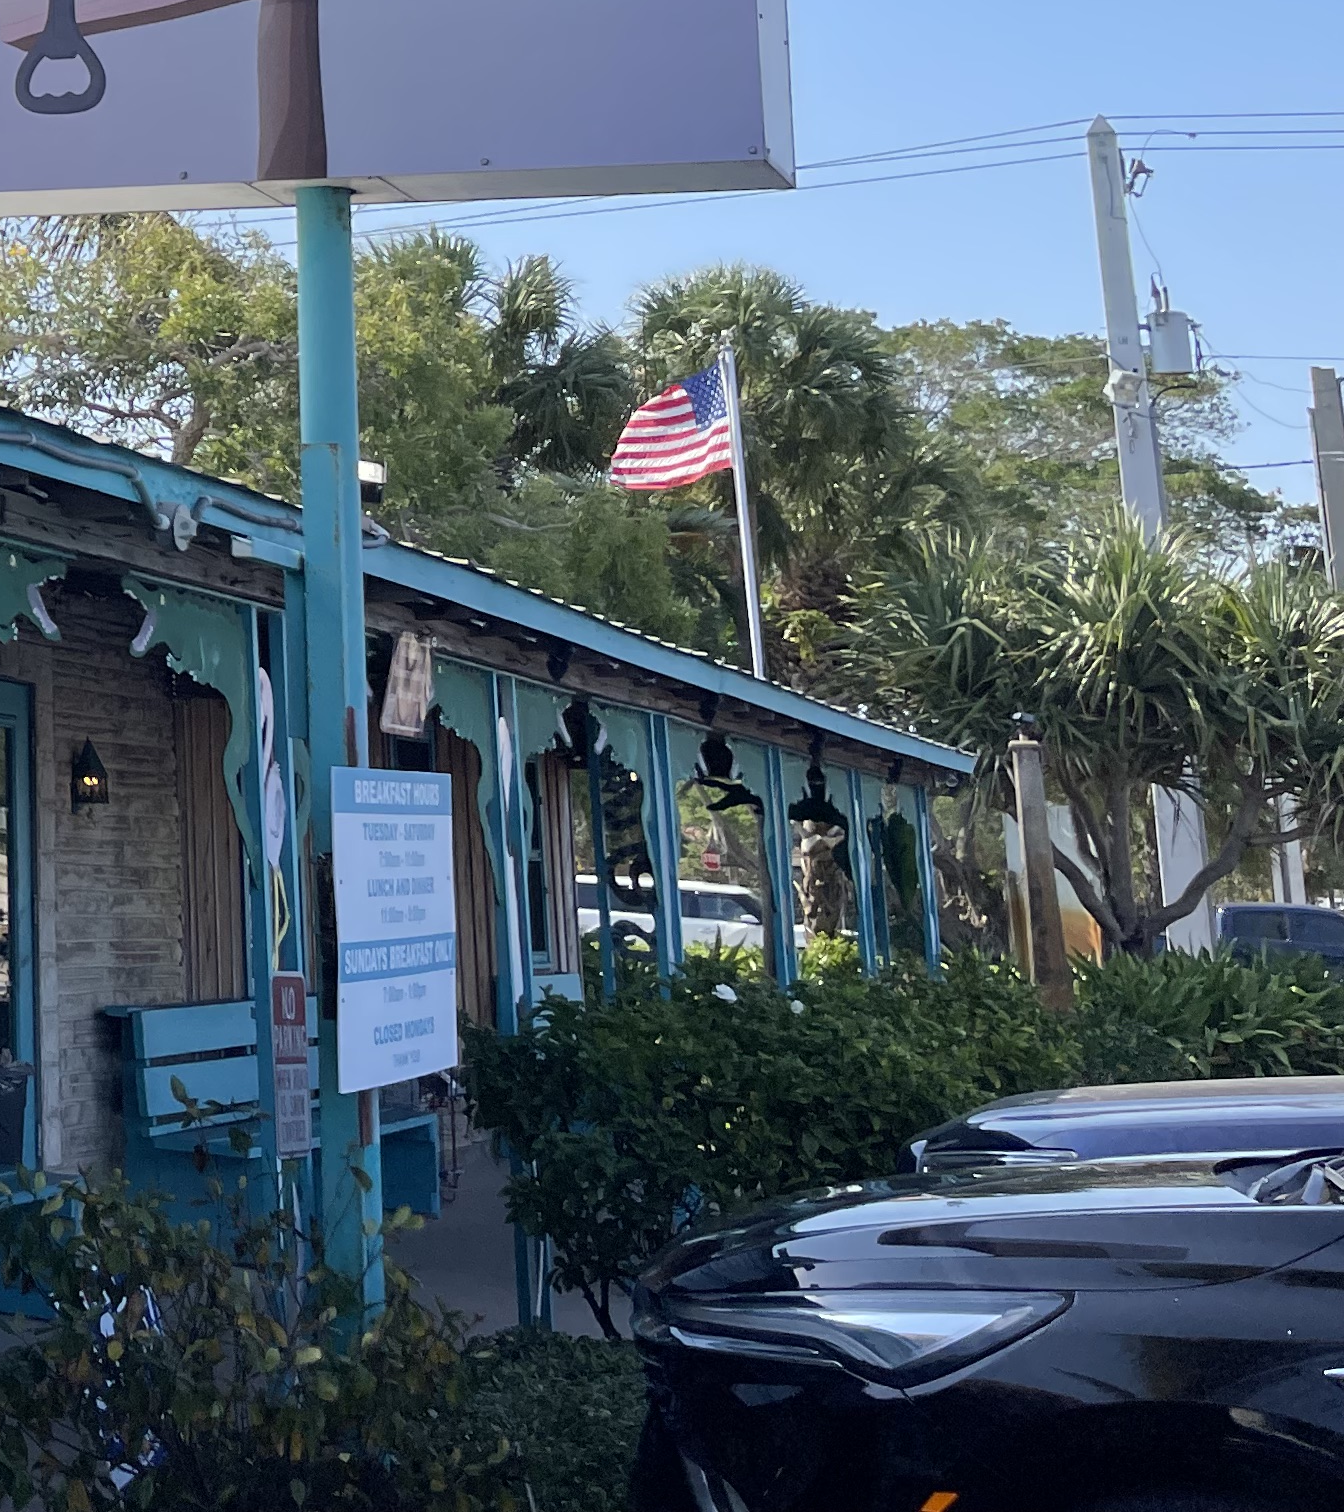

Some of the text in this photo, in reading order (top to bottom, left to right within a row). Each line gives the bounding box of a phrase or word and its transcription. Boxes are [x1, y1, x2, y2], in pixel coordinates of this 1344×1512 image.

[354, 780, 440, 806] BREAKFAST HOURS
[363, 823, 398, 840] TUESDAY
[367, 879, 394, 897] LUNCH
[396, 878, 410, 895] AND
[345, 939, 453, 974] SUNDAYS BREAKFAST ONLY
[281, 986, 296, 1020] NO
[374, 1016, 434, 1045] CLOSED MONDAYS
